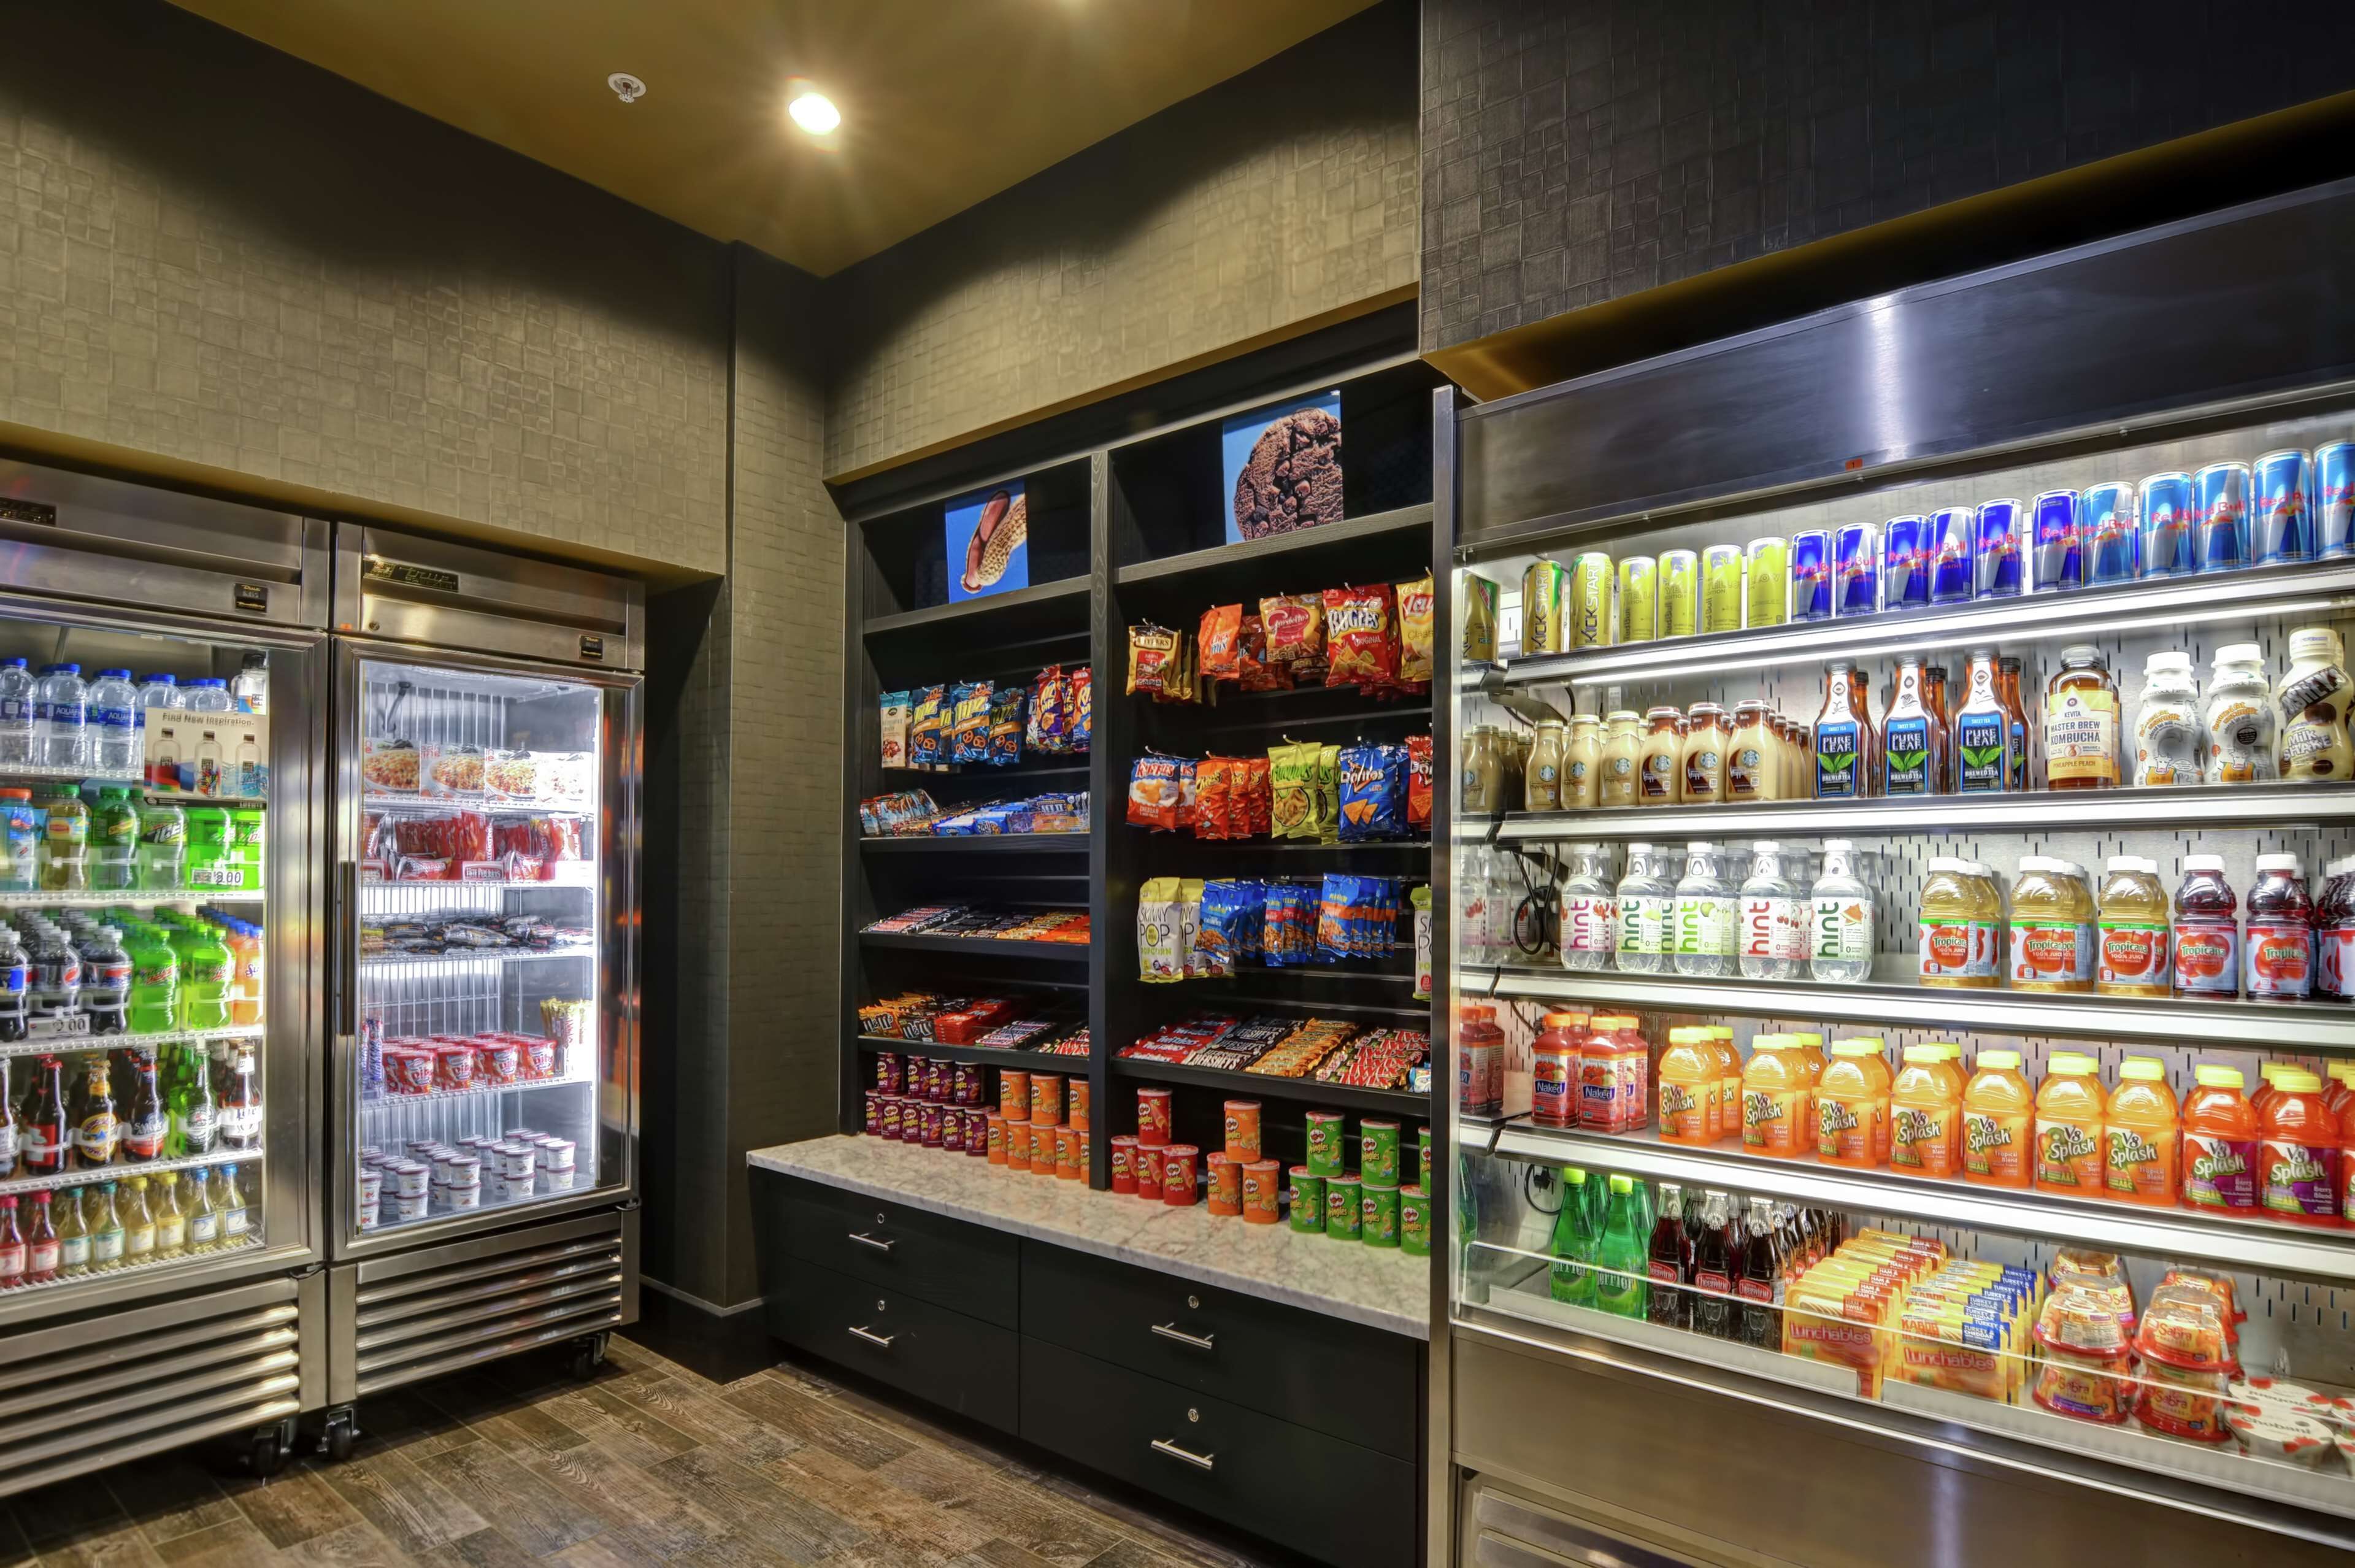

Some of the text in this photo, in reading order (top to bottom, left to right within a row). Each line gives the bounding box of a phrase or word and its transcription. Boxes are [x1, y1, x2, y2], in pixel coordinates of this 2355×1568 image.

[2322, 482, 2354, 497] Red
[2218, 501, 2245, 512] Bull
[2259, 494, 2288, 508] Red
[2151, 507, 2181, 523] Red
[2108, 518, 2132, 530] Bull
[2041, 526, 2069, 539] Red
[1942, 540, 1967, 552] Bull
[1978, 534, 2003, 549] Red
[1855, 556, 1875, 568] Bull
[1888, 549, 1911, 563] Red
[1531, 569, 1550, 649] KICKSTART
[1581, 562, 1600, 644] KICKSTART
[1328, 609, 1380, 639] BUGLES
[162, 712, 181, 721] Find
[1966, 728, 1996, 737] PURE
[2051, 722, 2075, 732] MASTER
[1823, 736, 1851, 745] PURE
[1892, 734, 1921, 743] PURE
[1966, 737, 1997, 747] LEAF
[2051, 732, 2100, 745] KOMBUCHA
[2288, 729, 2317, 747] Milk
[1823, 745, 1853, 753] LEAF
[1892, 742, 1923, 751] LEAF
[2283, 736, 2333, 762] SHAKE
[1139, 907, 1168, 923] SKINNY
[1570, 899, 1589, 950] hint
[1621, 900, 1640, 950] hint
[1680, 900, 1698, 952] hint
[1748, 901, 1770, 955] hint
[1818, 902, 1839, 956] hint
[1140, 924, 1170, 947] POP
[2107, 941, 2148, 954] Tropicana
[2181, 945, 2226, 958] Tropicana
[1536, 1082, 1563, 1093] Naked
[1585, 1086, 1613, 1099] Naked
[1670, 1085, 1683, 1100] V8
[1662, 1095, 1696, 1115] Splash
[1755, 1093, 1770, 1108] V8
[1746, 1103, 1782, 1124] Splash
[1829, 1104, 1845, 1118] V8
[1911, 1111, 1929, 1127] V8
[1821, 1113, 1857, 1134] Splash
[1899, 1121, 1941, 1142] Splash
[1979, 1118, 1997, 1134] V8
[1969, 1129, 2011, 1151] Splash
[2064, 1126, 2083, 1143] V8
[2122, 1131, 2142, 1148] V8
[1994, 1150, 2018, 1158] Tropical
[2050, 1137, 2096, 1159] Splash
[2110, 1143, 2157, 1166] Splash
[2209, 1140, 2230, 1159] V8
[2287, 1146, 2309, 1164] V8
[2194, 1154, 2245, 1178] Splash
[2270, 1161, 2326, 1185] Splash
[2313, 1186, 2332, 1194] Berry
[1789, 1321, 1872, 1345] Lunchables
[1964, 1331, 1994, 1339] CHEDDAR
[2159, 1323, 2192, 1340] Sabra
[1904, 1347, 1996, 1370] Lunchables
[2154, 1391, 2188, 1409] Sabra
